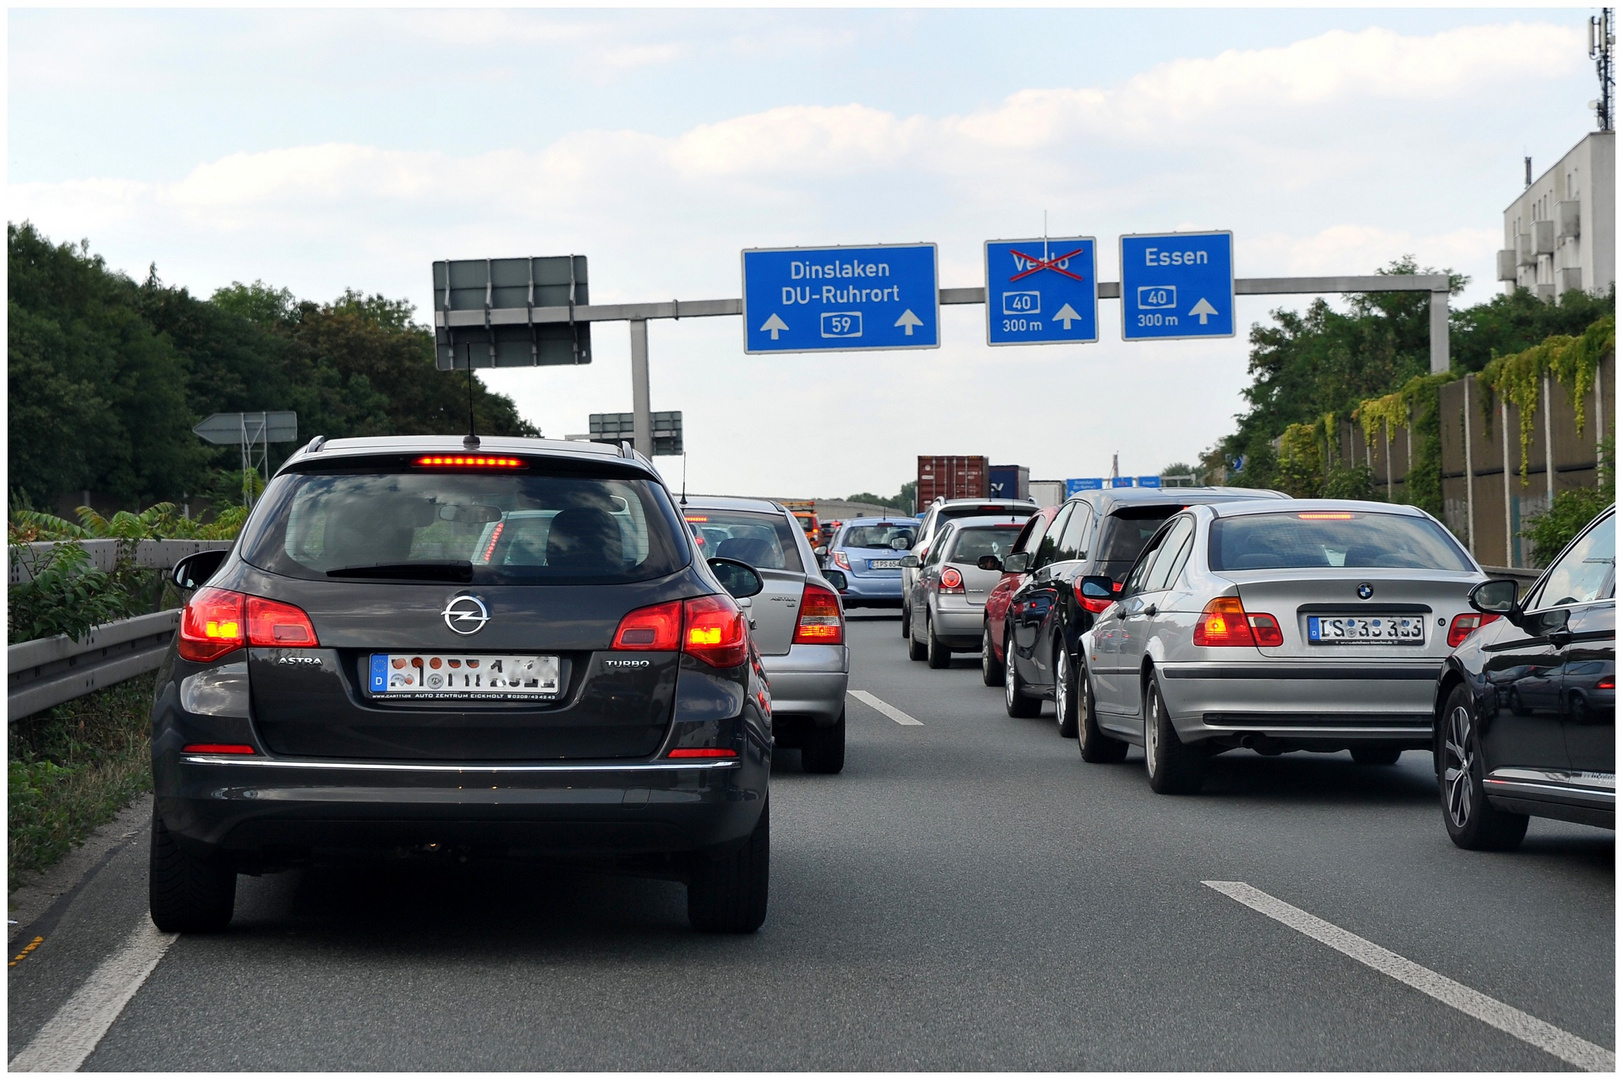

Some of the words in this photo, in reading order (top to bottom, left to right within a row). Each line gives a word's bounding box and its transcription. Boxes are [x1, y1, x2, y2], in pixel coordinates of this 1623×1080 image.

[1145, 248, 1208, 266] Essen
[790, 259, 890, 280] Dinslaken
[781, 284, 900, 305] DU-Ruhrort
[1148, 290, 1167, 305] 40
[1012, 295, 1031, 310] 40
[831, 316, 851, 333] 59
[1002, 319, 1027, 332] 300
[1029, 321, 1042, 331] m
[1137, 314, 1163, 327] 300
[1165, 315, 1178, 326] m
[278, 656, 323, 666] ASTRA
[605, 660, 650, 668] TURBO
[375, 676, 383, 686] D
